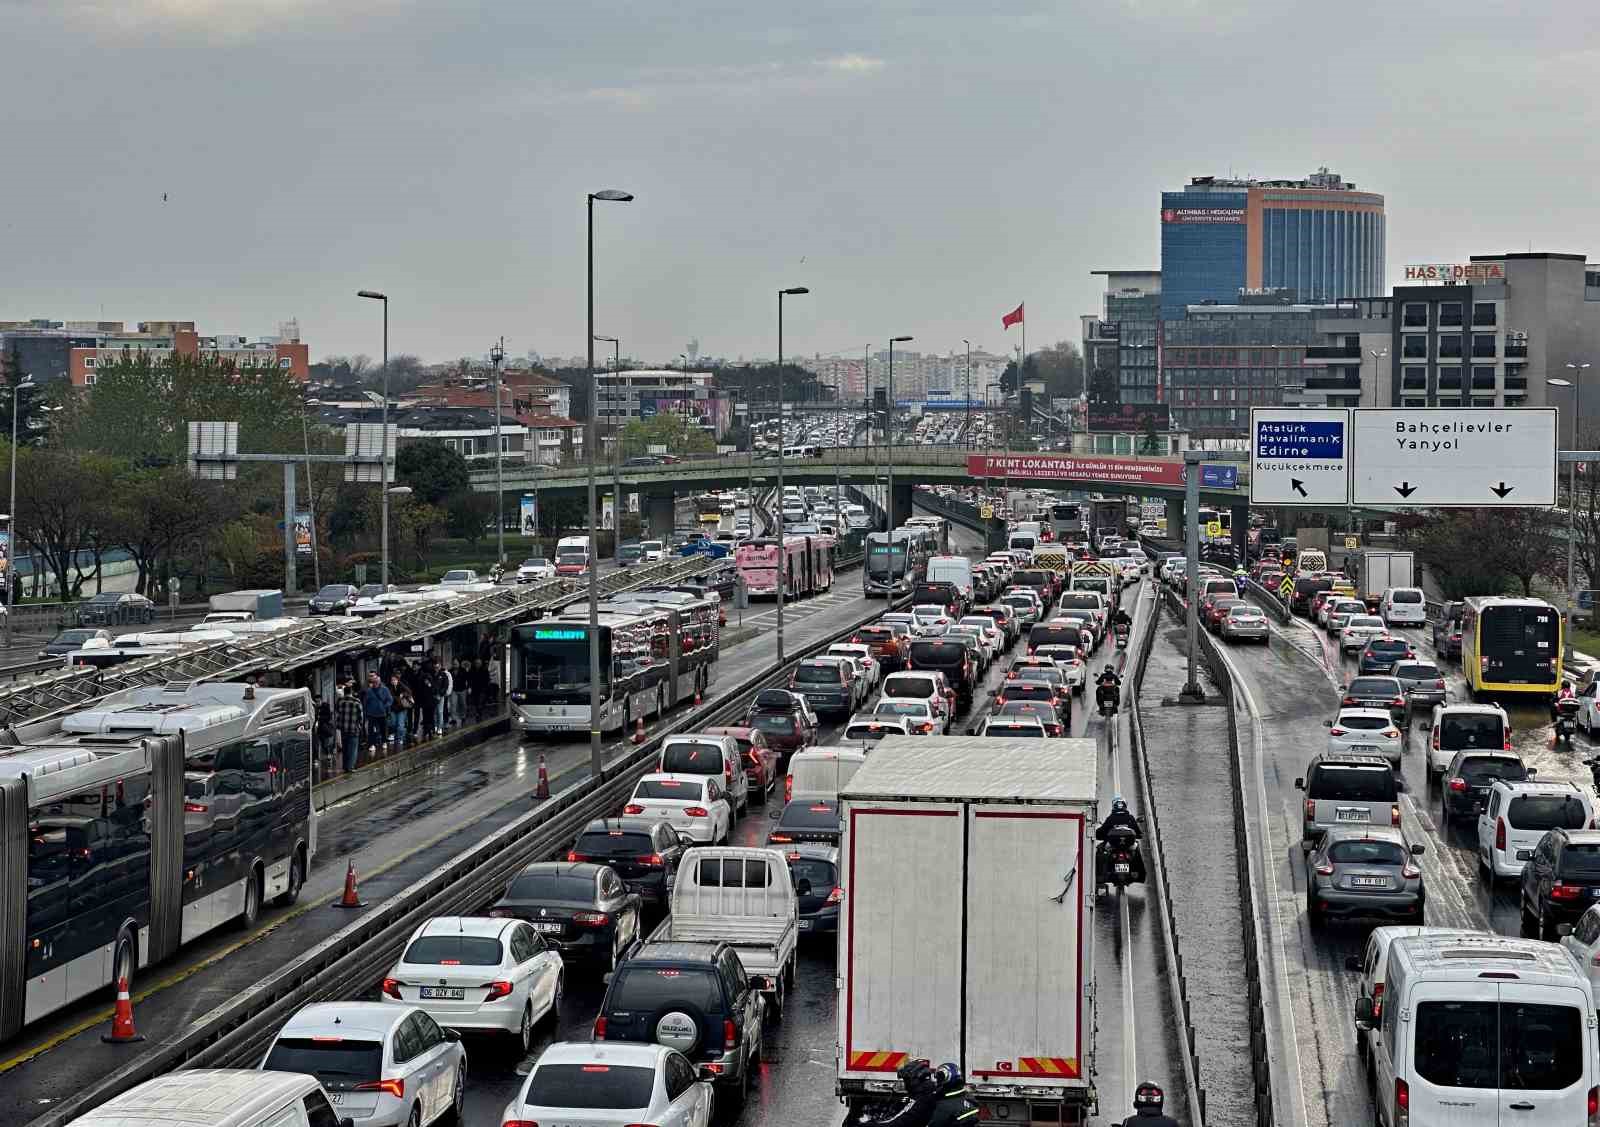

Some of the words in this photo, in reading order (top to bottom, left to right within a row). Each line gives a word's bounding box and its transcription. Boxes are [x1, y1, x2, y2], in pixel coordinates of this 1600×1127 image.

[1406, 266, 1437, 279] HAS
[1454, 265, 1504, 279] DELTA
[1260, 424, 1307, 433] Atatürk
[1396, 421, 1513, 434] Bahçelievler
[1260, 434, 1329, 443] Havalimanı
[1260, 445, 1309, 456] Edirne
[1396, 438, 1459, 452] Yanyol
[1022, 459, 1075, 470] LOKANTASI
[1256, 462, 1344, 471] Küçükçekmece
[662, 1025, 692, 1033] SUZUKI
